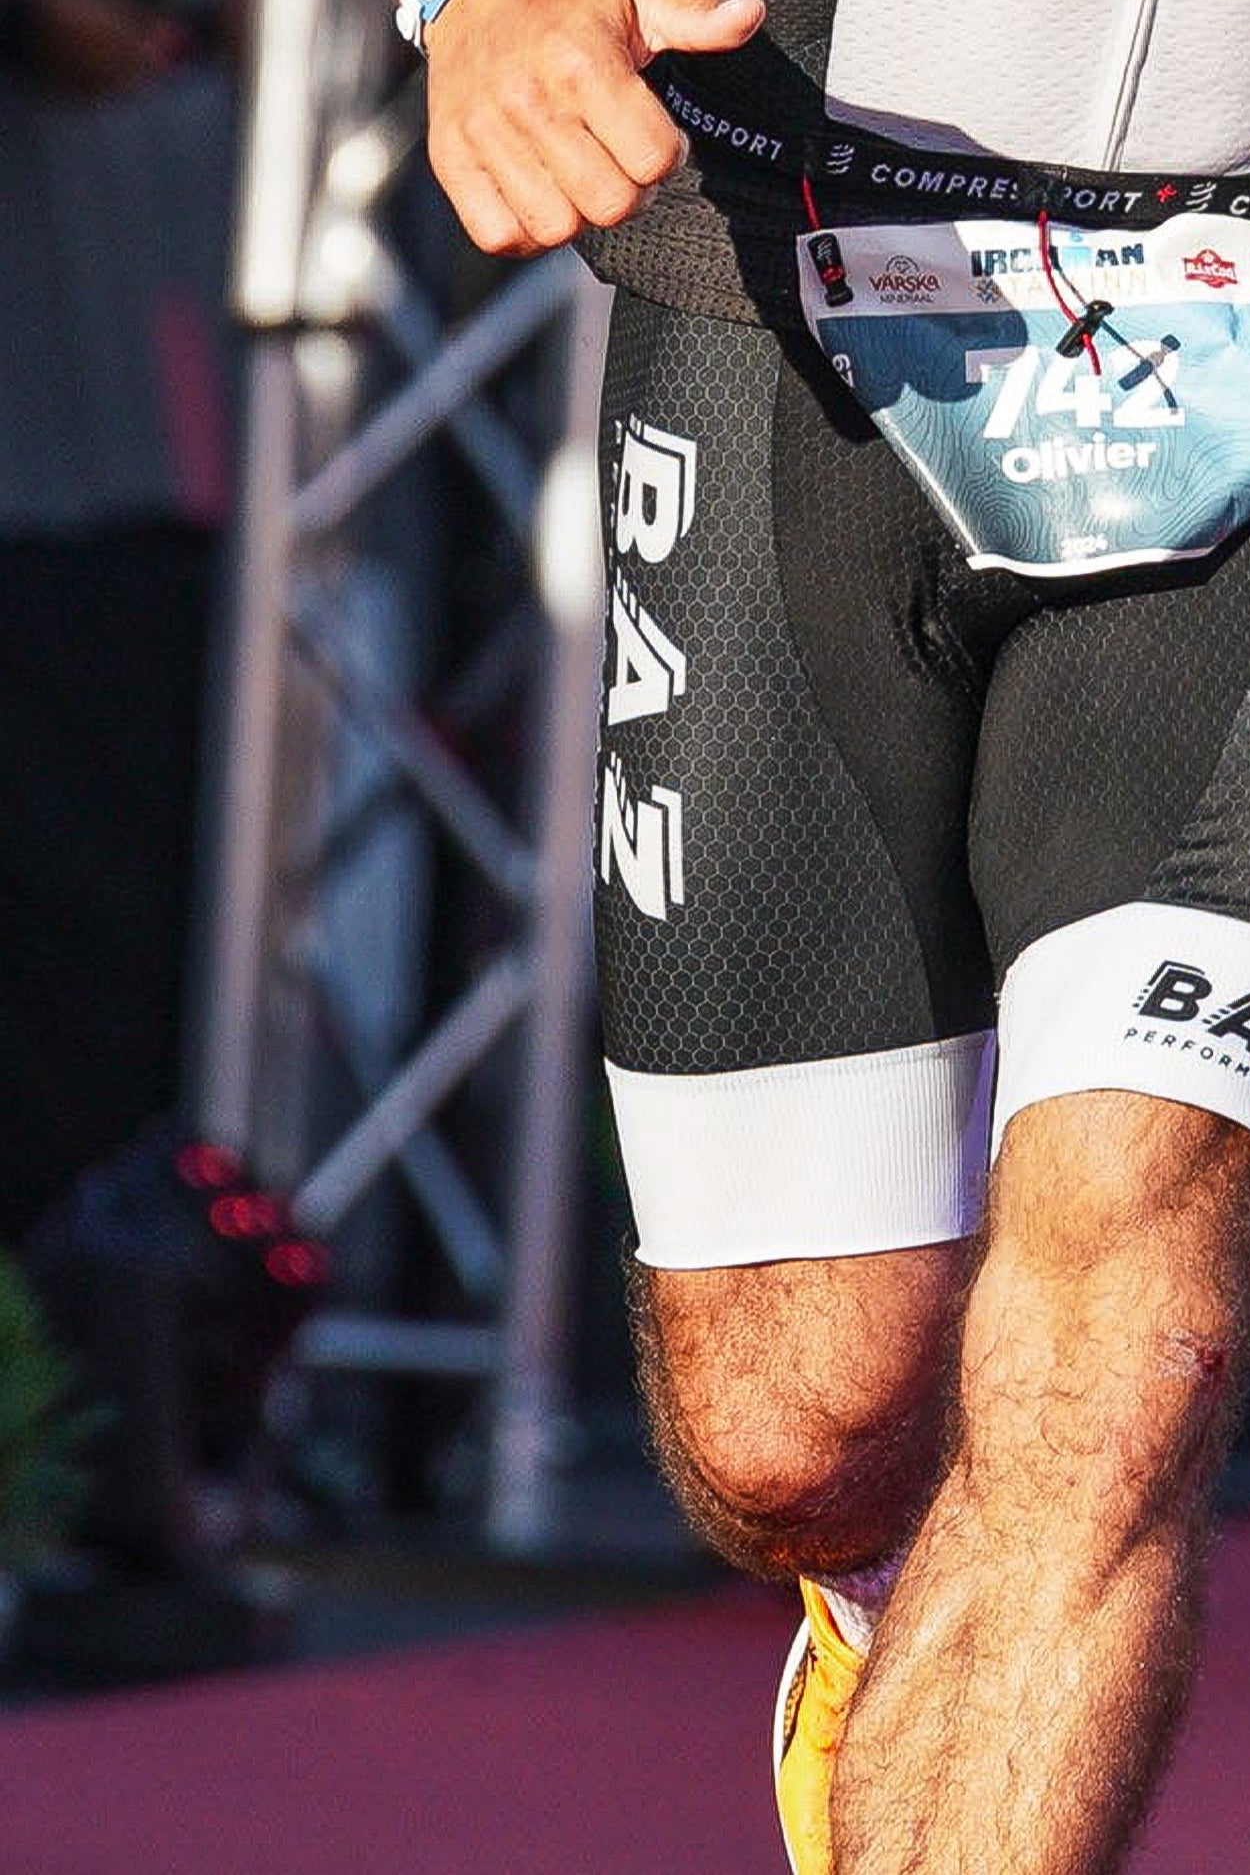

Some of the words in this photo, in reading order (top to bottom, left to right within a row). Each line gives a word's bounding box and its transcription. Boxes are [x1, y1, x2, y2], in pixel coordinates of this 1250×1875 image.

[664, 83, 785, 161] PRESSPORT
[870, 162, 1143, 214] COMPREORT
[970, 242, 1145, 278] IROAN
[965, 338, 1186, 439] 742
[1002, 432, 1158, 483] Olivier
[602, 415, 697, 921] BAZ
